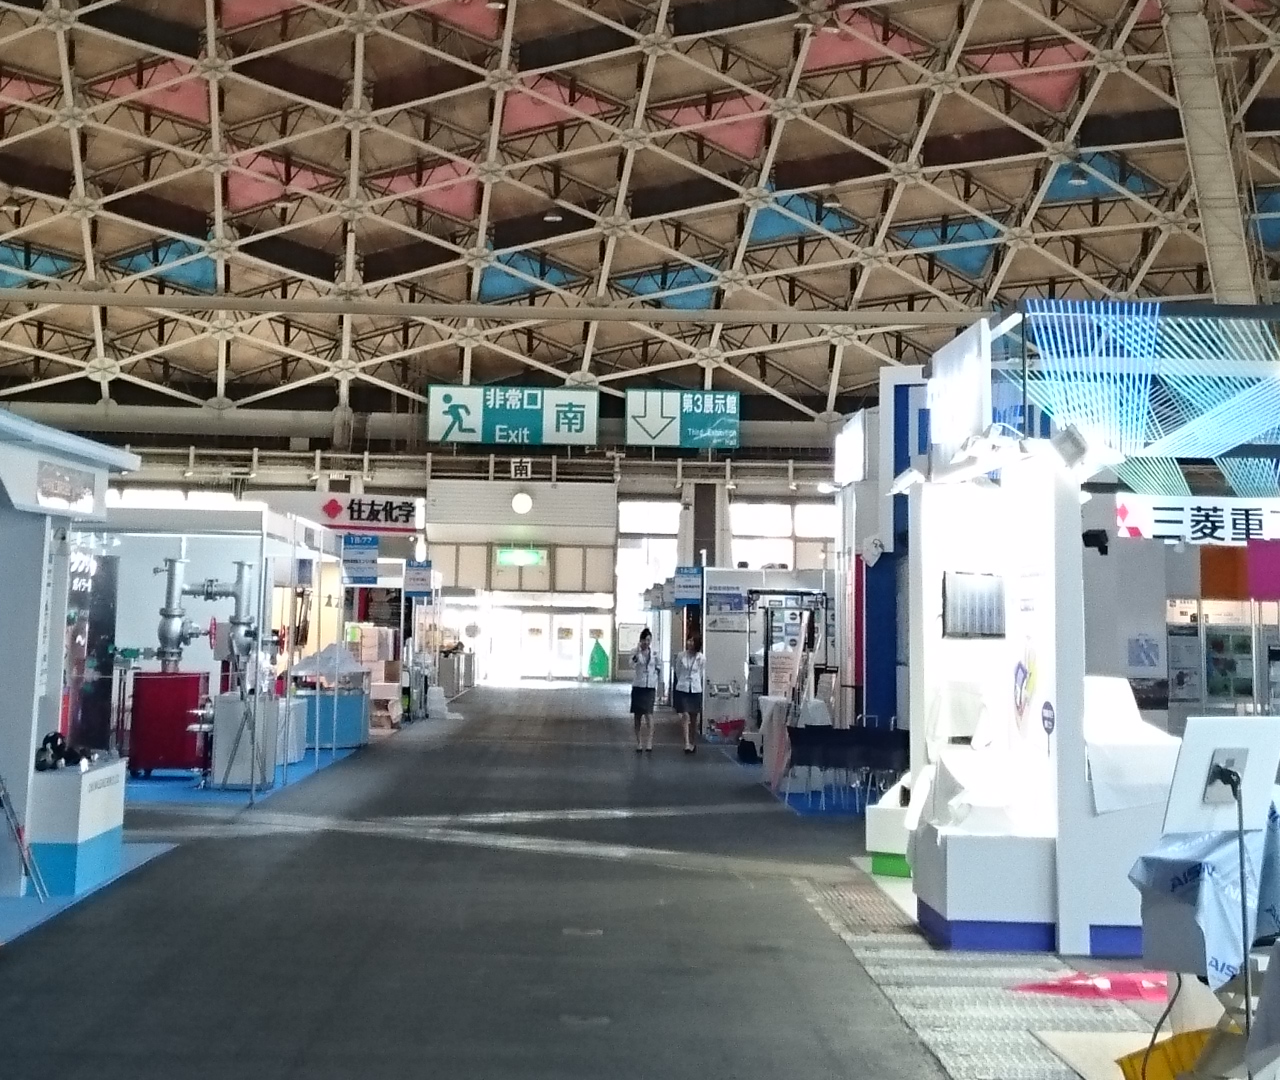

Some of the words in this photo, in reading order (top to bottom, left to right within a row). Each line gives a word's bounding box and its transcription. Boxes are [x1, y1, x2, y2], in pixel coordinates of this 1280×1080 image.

[486, 389, 542, 410] 非常口
[683, 393, 737, 415] 第3展示館
[555, 402, 586, 434] 南
[495, 425, 530, 444] Exit
[347, 498, 416, 523] 住友化学
